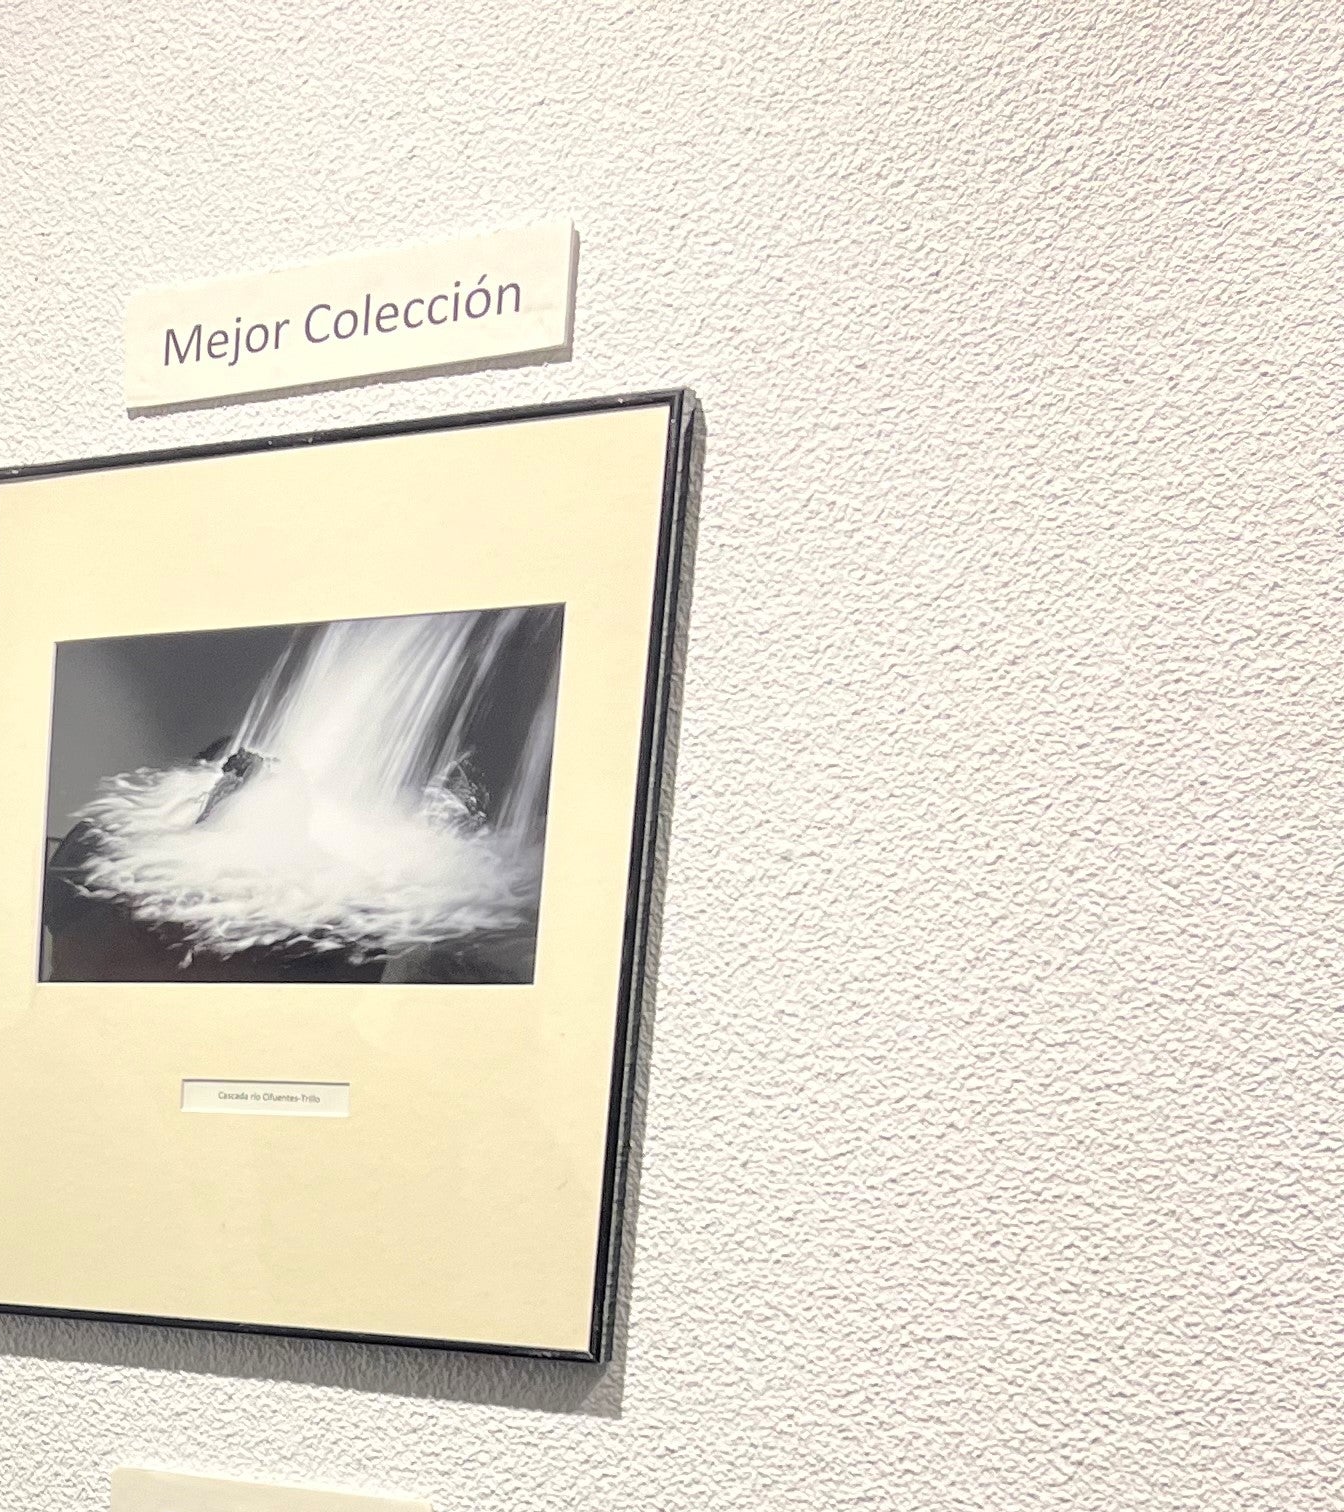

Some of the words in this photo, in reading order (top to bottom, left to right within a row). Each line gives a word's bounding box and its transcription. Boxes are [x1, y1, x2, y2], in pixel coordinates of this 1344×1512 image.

[163, 316, 291, 367] Mejor
[304, 273, 522, 345] Colección
[217, 1091, 249, 1101] Cascada
